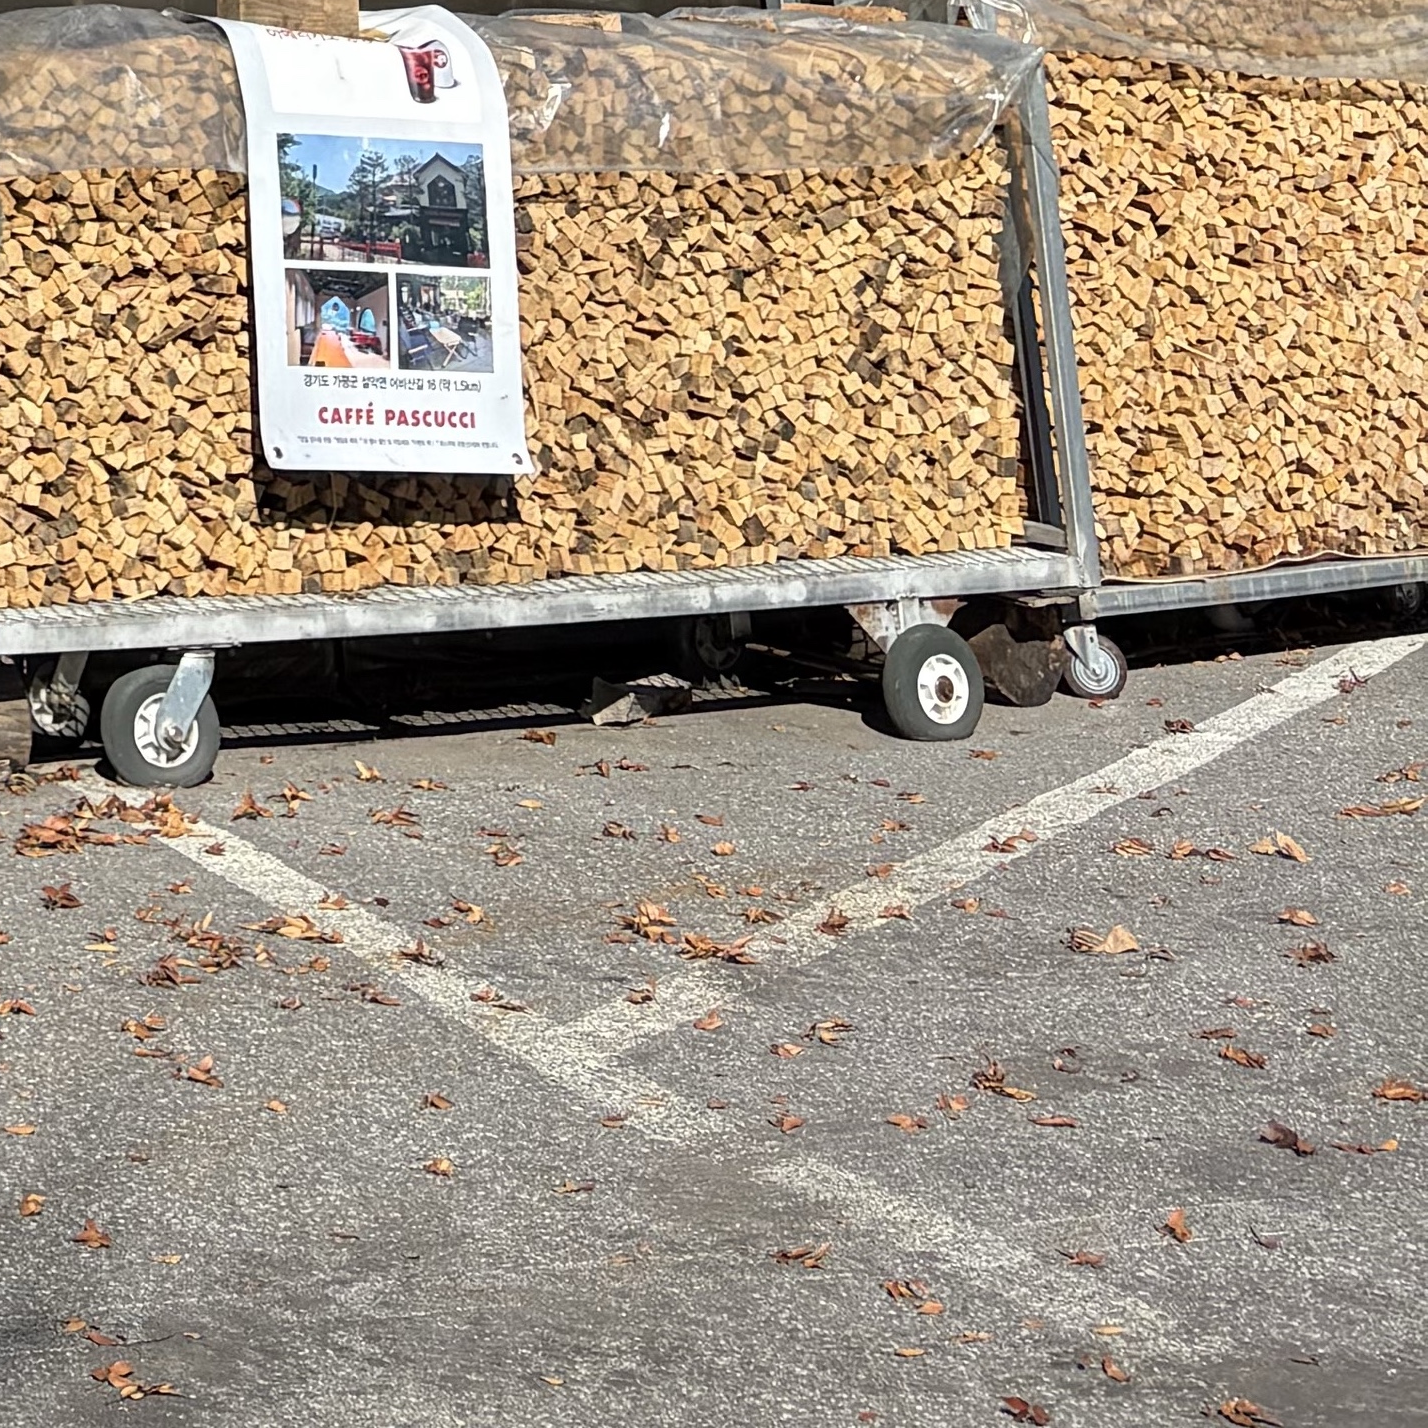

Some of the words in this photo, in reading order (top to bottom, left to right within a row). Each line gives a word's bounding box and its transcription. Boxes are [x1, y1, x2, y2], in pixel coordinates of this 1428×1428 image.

[303, 374, 330, 388] 경기도
[332, 375, 358, 389] 가평군
[317, 401, 375, 425] CAFFÉ
[384, 408, 477, 429] PASCUCCI
